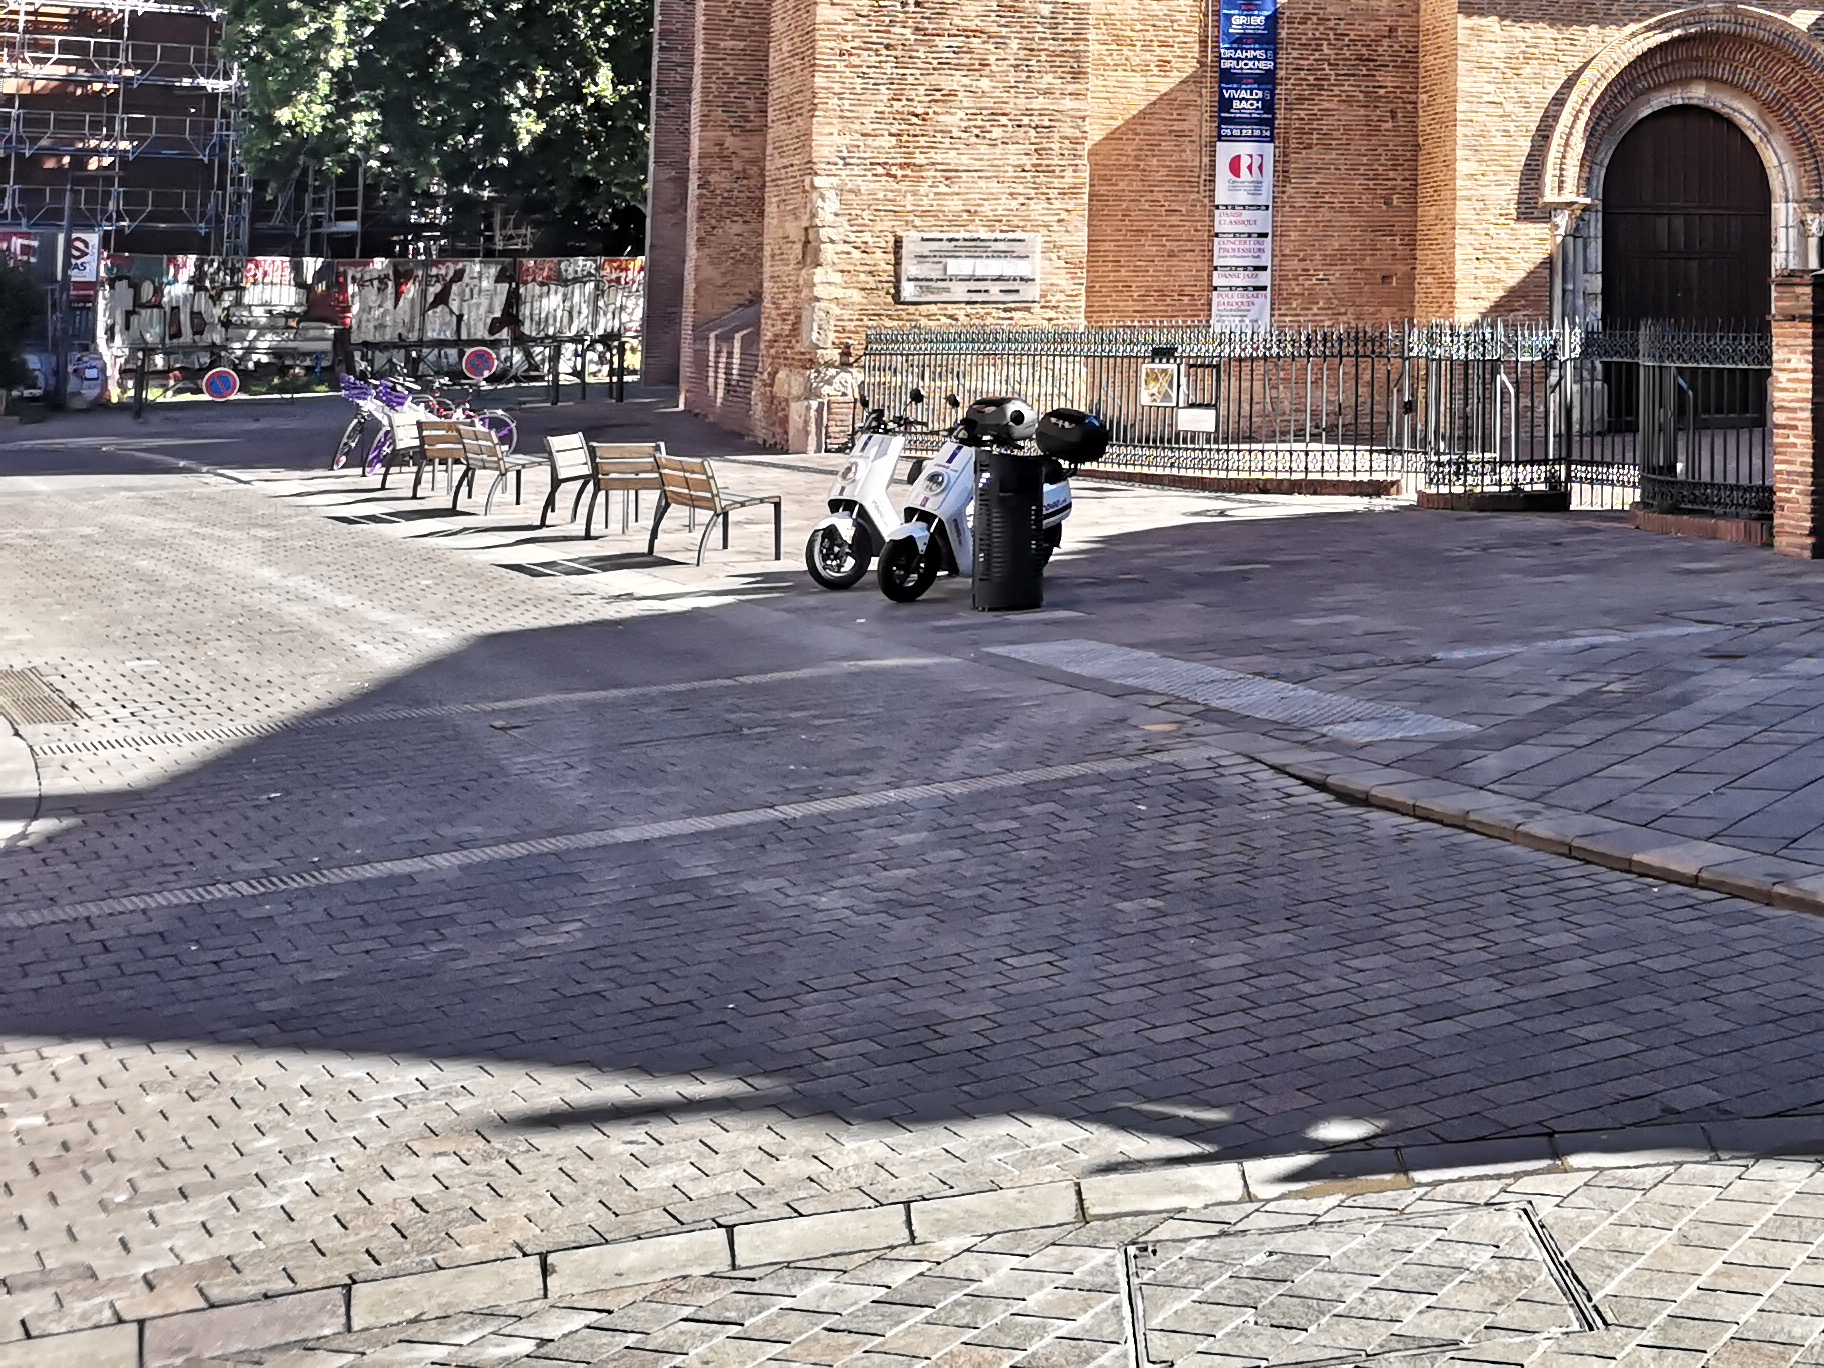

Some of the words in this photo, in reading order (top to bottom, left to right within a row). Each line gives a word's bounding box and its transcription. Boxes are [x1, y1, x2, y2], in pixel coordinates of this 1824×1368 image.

[1232, 16, 1265, 25] GRIEG
[1220, 49, 1266, 59] BRAHMS
[1220, 59, 1274, 70] BRUCKNER
[1222, 89, 1263, 99] VIVALDI
[1232, 100, 1262, 109] BACH
